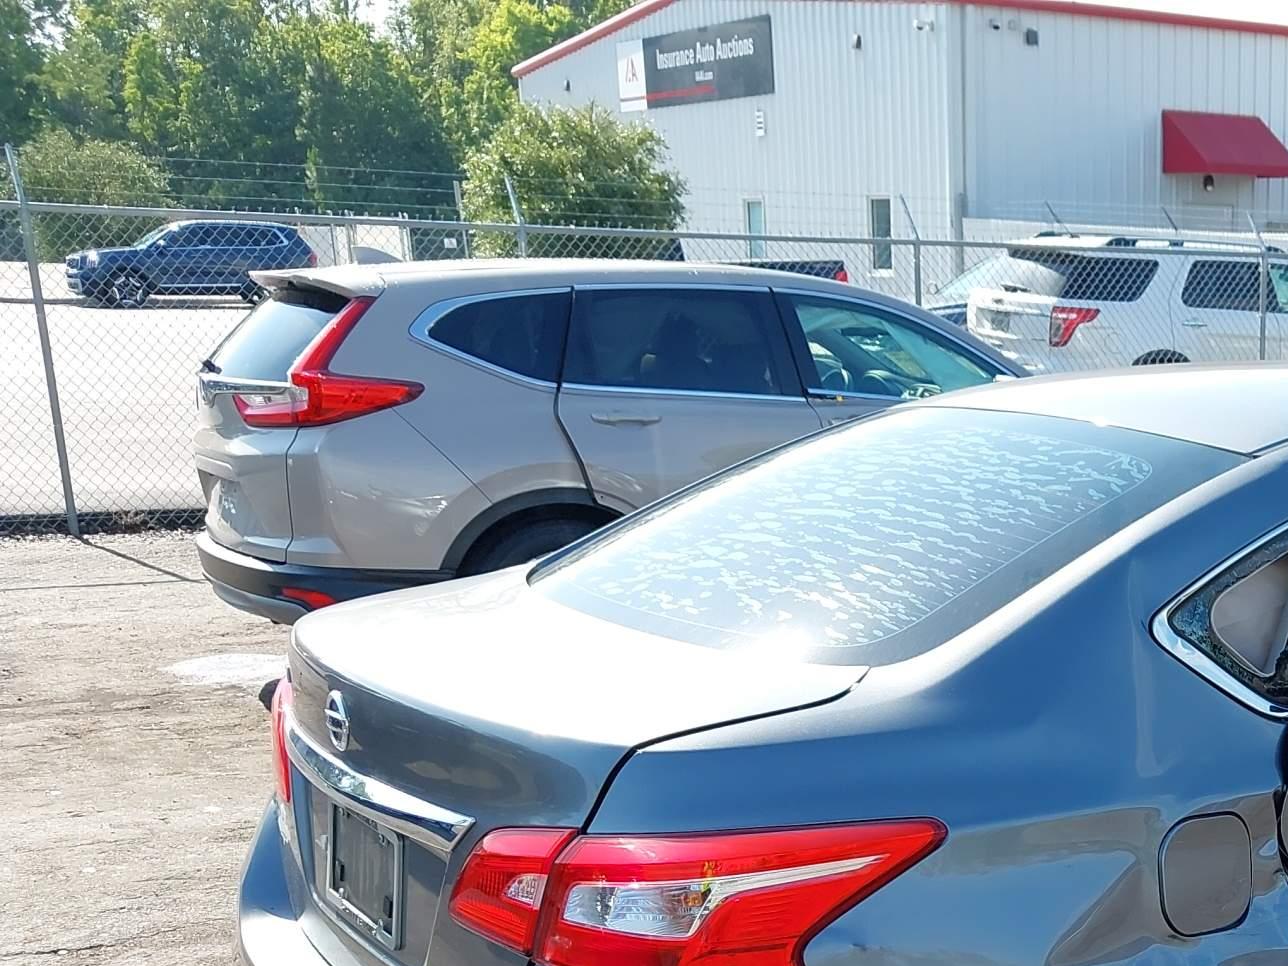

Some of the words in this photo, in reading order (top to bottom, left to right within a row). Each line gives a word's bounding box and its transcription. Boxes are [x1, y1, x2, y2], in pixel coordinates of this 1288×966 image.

[656, 48, 695, 70] Insurance
[695, 42, 715, 64] Auto
[716, 35, 754, 61] Auctions
